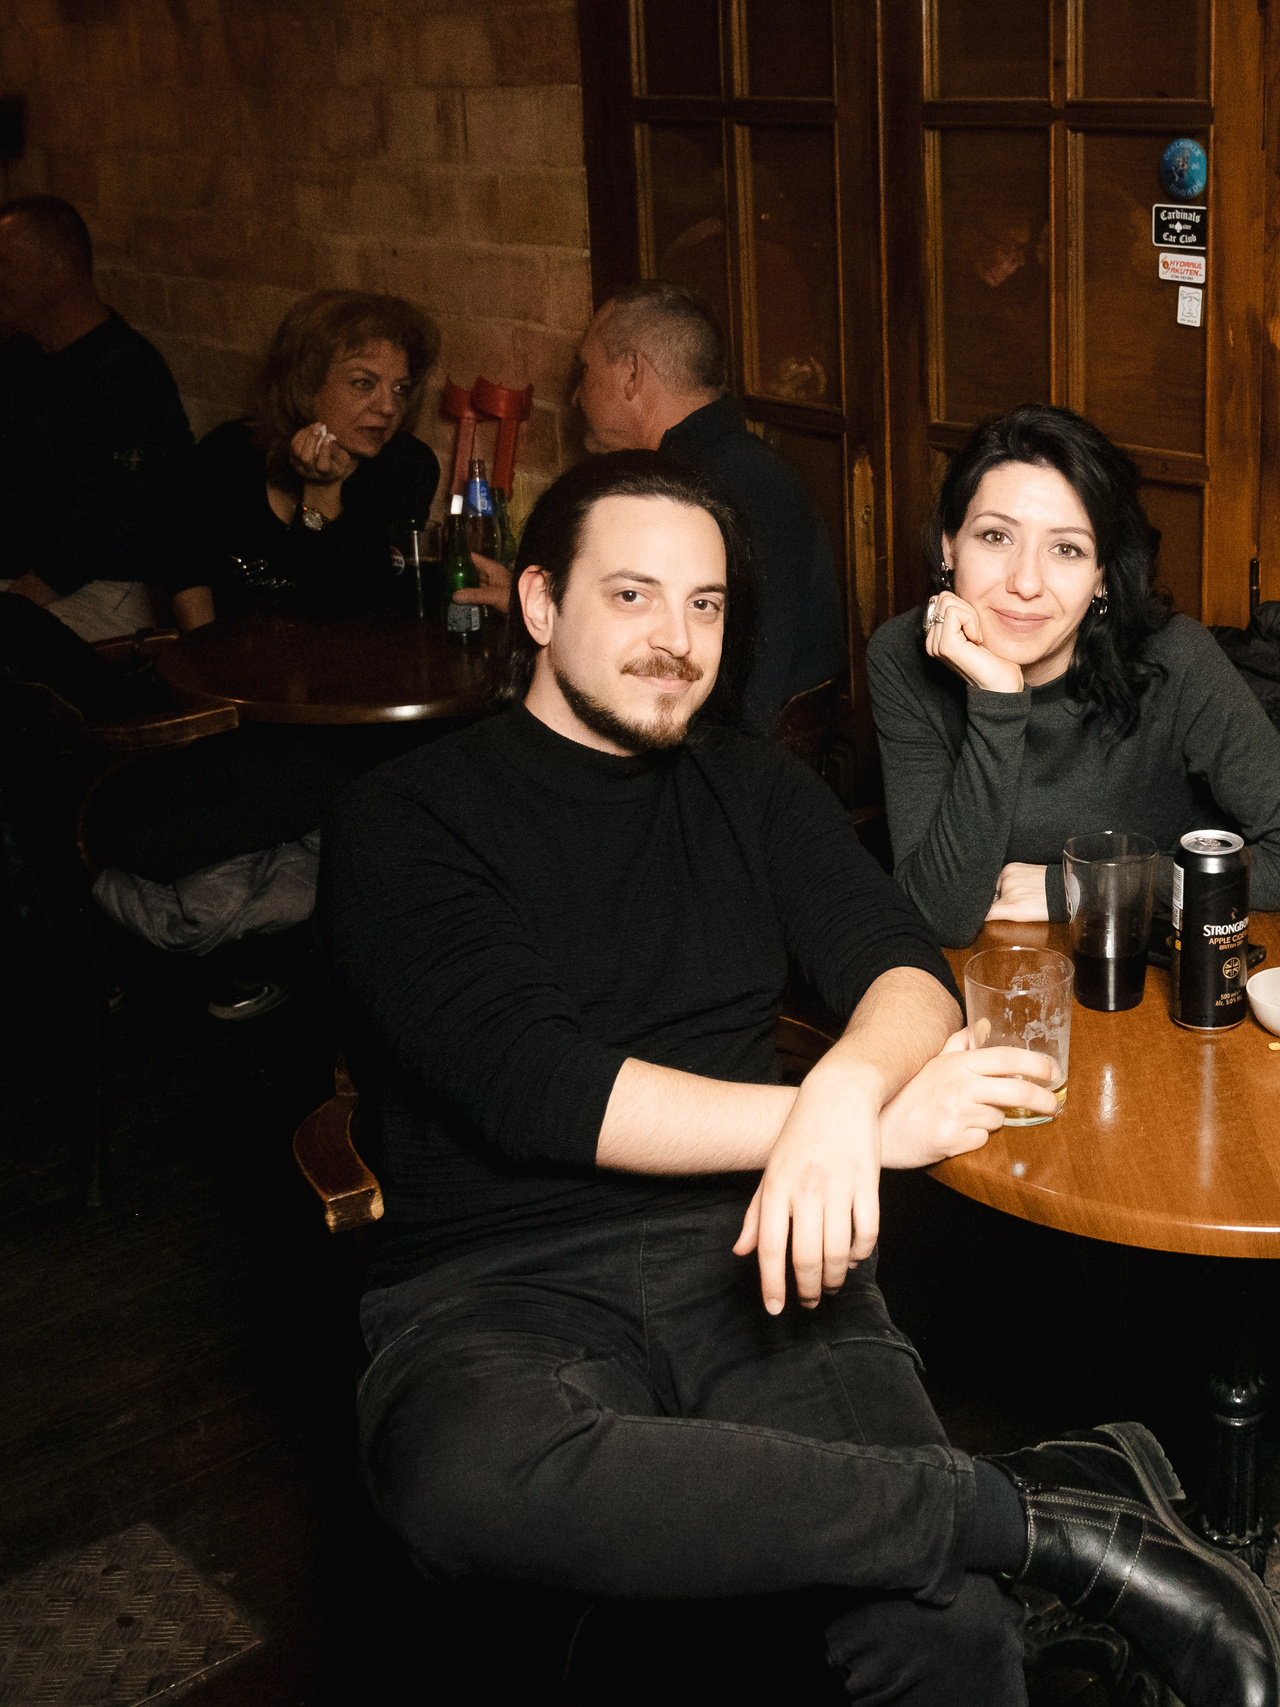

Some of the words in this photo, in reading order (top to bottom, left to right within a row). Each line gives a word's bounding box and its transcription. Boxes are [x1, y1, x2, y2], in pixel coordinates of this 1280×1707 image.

[1160, 209, 1201, 223] Cardinals
[1162, 232, 1177, 243] Car
[1179, 234, 1197, 244] Club
[1208, 936, 1231, 945] APPLE
